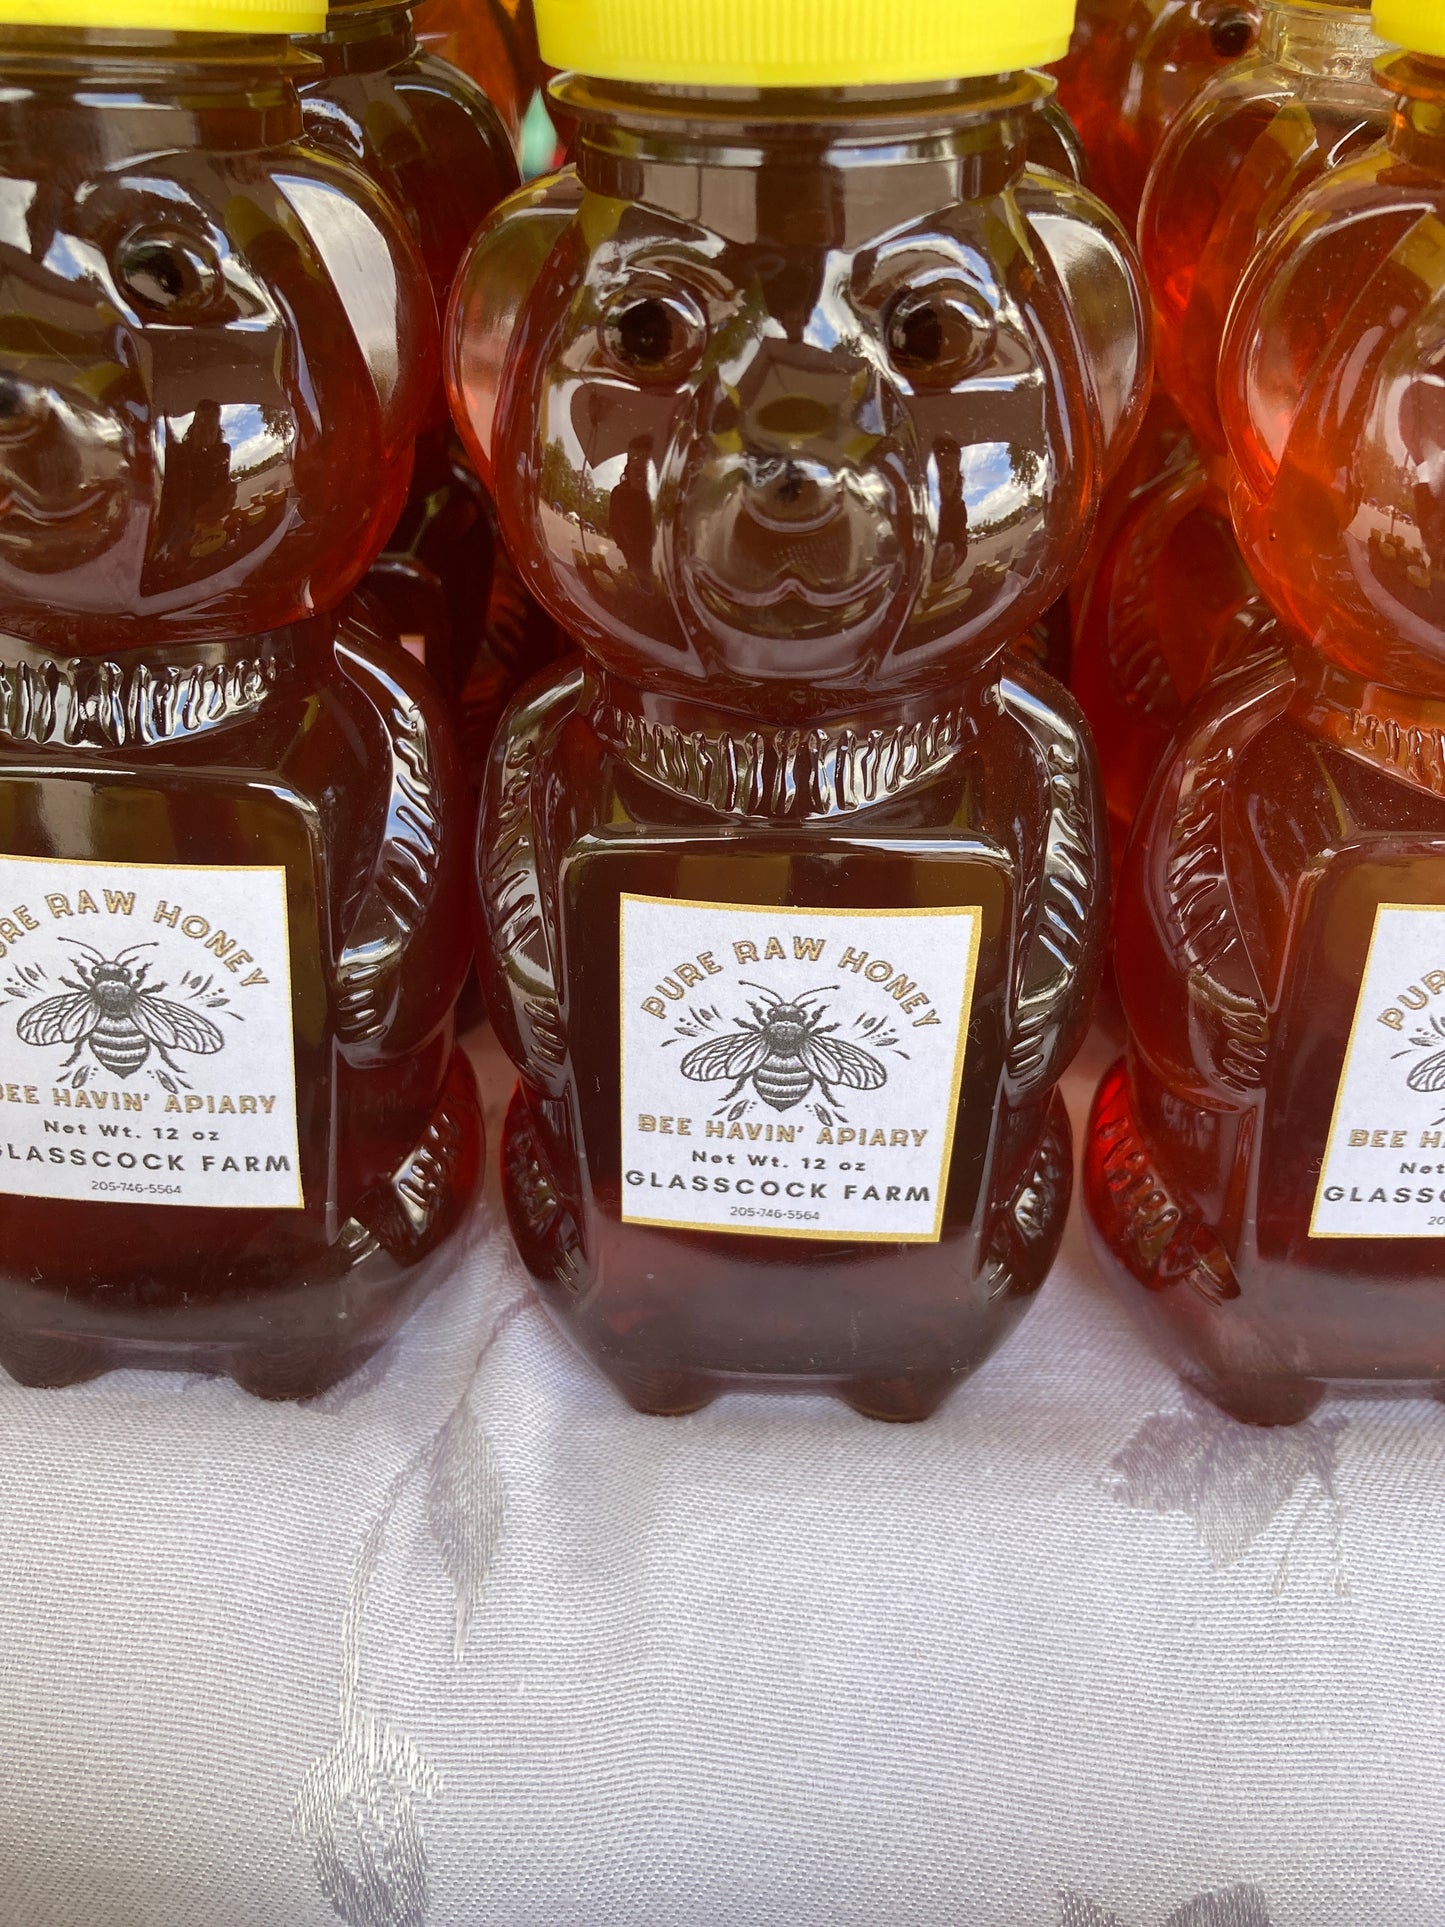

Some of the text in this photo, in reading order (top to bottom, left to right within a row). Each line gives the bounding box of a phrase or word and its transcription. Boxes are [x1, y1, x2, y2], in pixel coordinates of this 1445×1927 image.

[0, 889, 270, 989] RE RAW HONEY
[641, 936, 941, 1028] PURE RAW HONEY
[0, 1083, 277, 1114] EE HAVIN' APIARY
[44, 1119, 220, 1142] Net Wt. 12 oz
[637, 1114, 928, 1147] BEE HAVIN' APIARY
[1347, 1128, 1445, 1149] BEE H
[0, 1143, 291, 1172] LASSCOCK FARM
[692, 1150, 867, 1172] Net Wt. 12 oz
[91, 1180, 182, 1195] 205-746-5564
[625, 1169, 930, 1202] GLASSCOCK FARM
[1323, 1186, 1445, 1203] GLASS
[729, 1206, 820, 1221] 205-746-5564
